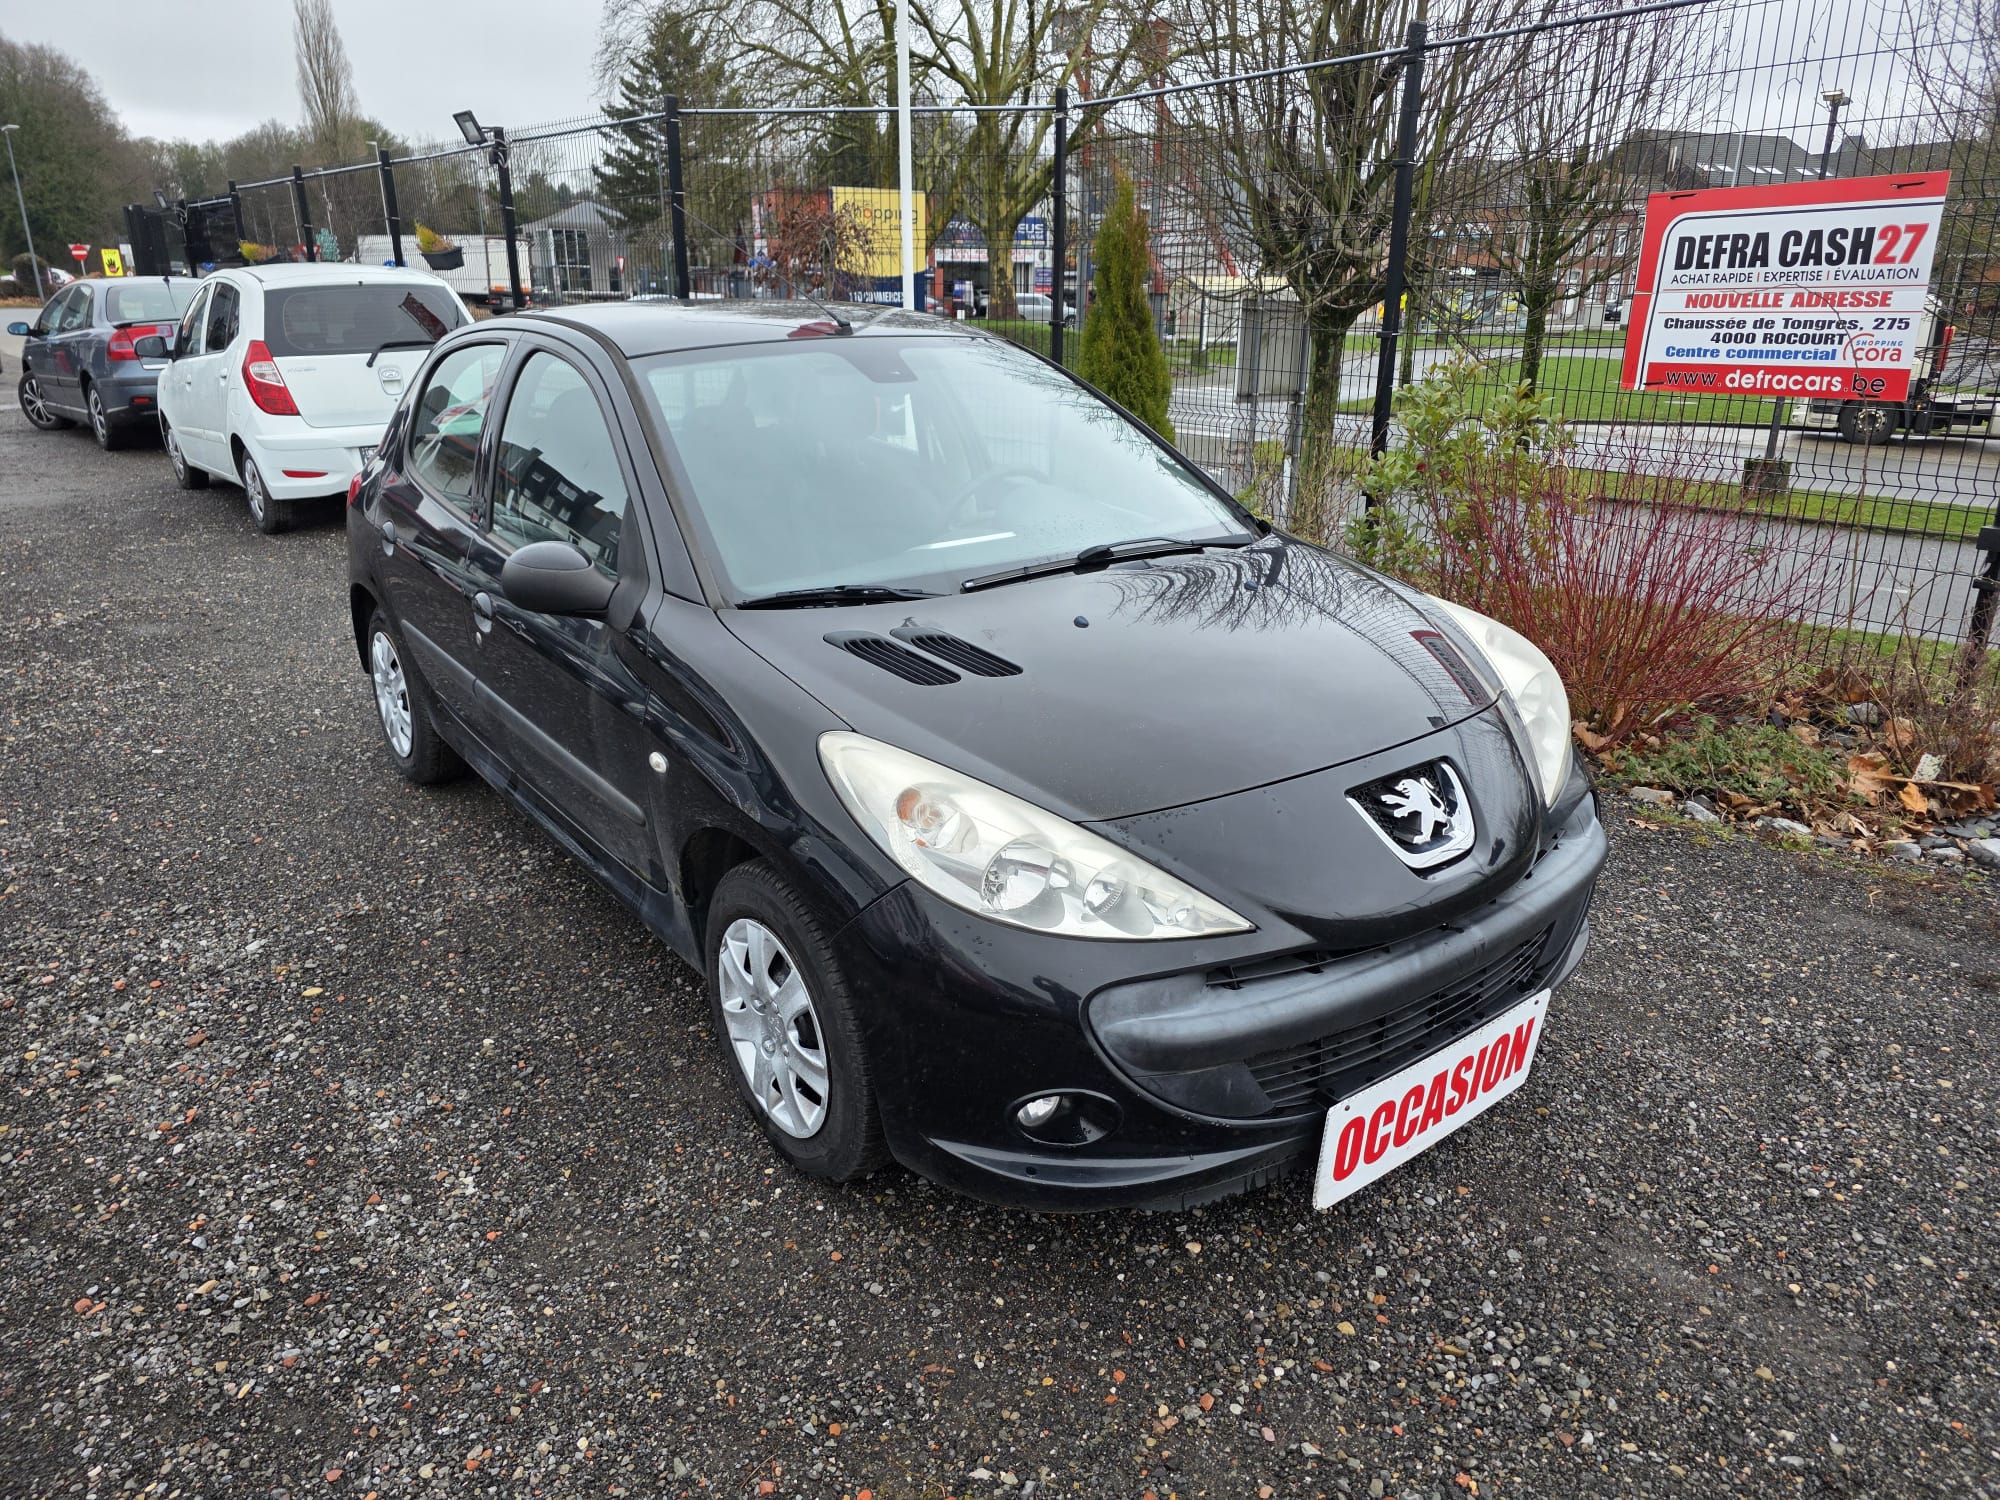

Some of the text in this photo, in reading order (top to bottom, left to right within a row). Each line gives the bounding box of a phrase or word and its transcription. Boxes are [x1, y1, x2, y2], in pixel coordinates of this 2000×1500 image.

[846, 206, 918, 225] hoppig
[1674, 223, 1929, 270] DEFRA CASH27
[1671, 268, 1919, 284] ACHAT RAPIDE EXPERTISE ÉVALUATION
[1685, 291, 1893, 308] NOUVELLE ADRESSE
[1664, 317, 1910, 331] Chaussée de Tongres, 275
[1710, 333, 1847, 345] 4000 ROCOURT
[1666, 346, 1837, 360] Centre commercial
[1853, 347, 1902, 361] cora
[1333, 1016, 1536, 1182] OCCASION
